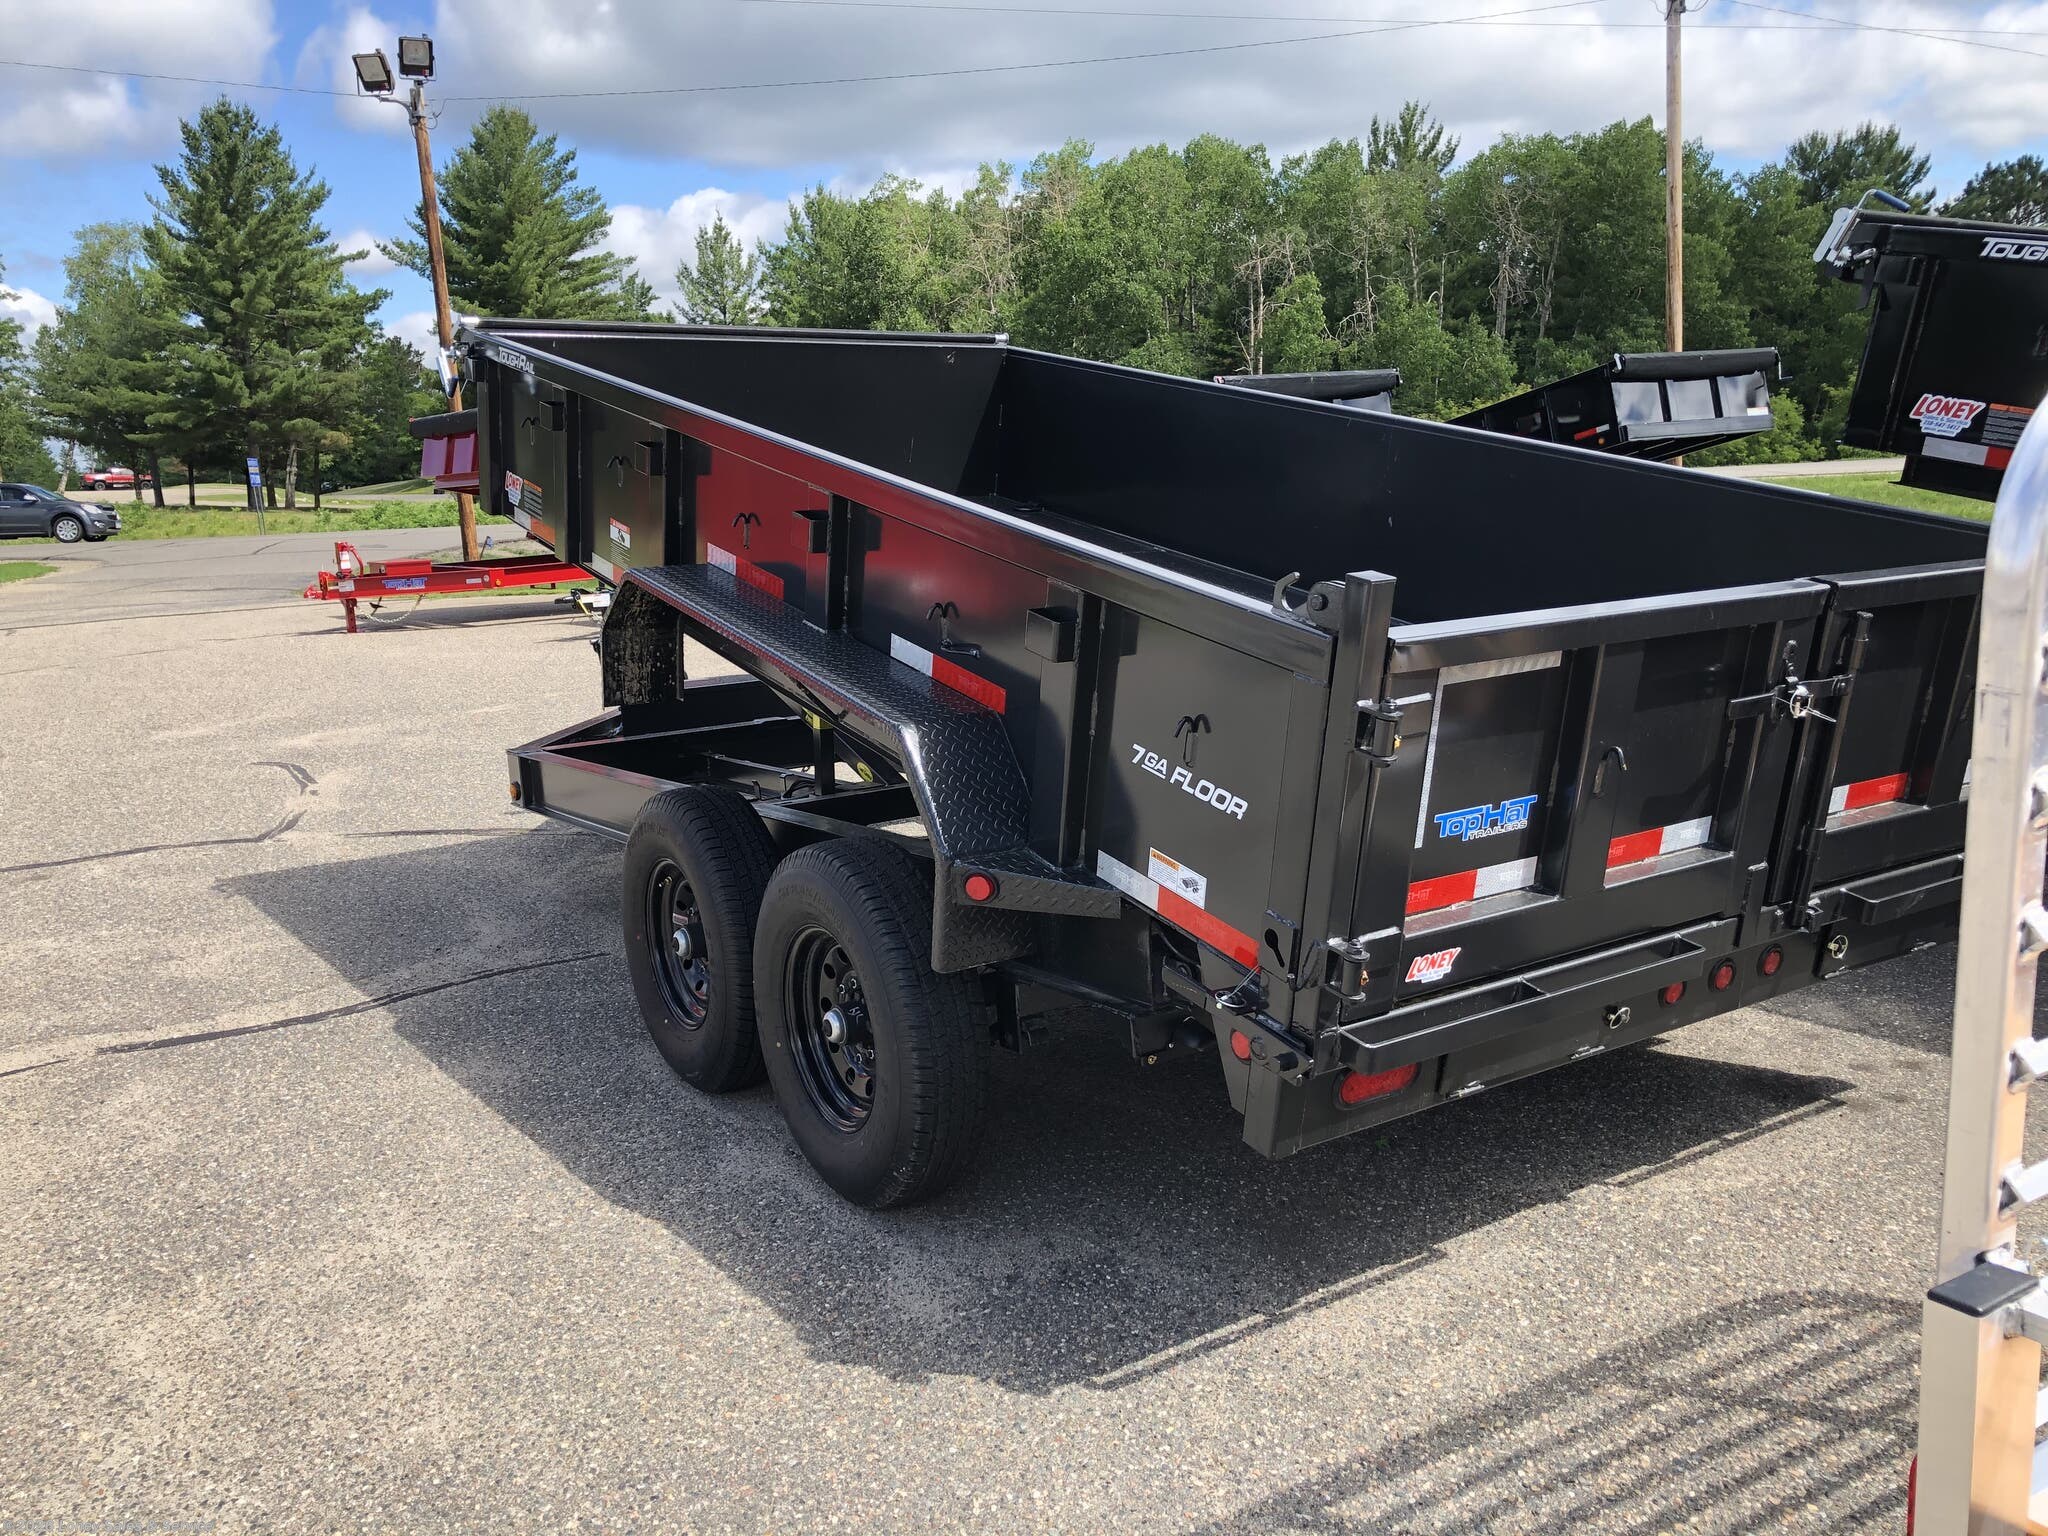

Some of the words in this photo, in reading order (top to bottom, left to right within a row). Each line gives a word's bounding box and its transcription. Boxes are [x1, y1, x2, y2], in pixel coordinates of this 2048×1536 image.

[1912, 396, 1982, 420] LONEY
[1169, 766, 1249, 820] FLOOR
[1469, 820, 1528, 840] TRAILERS
[1407, 948, 1459, 980] LONEY
